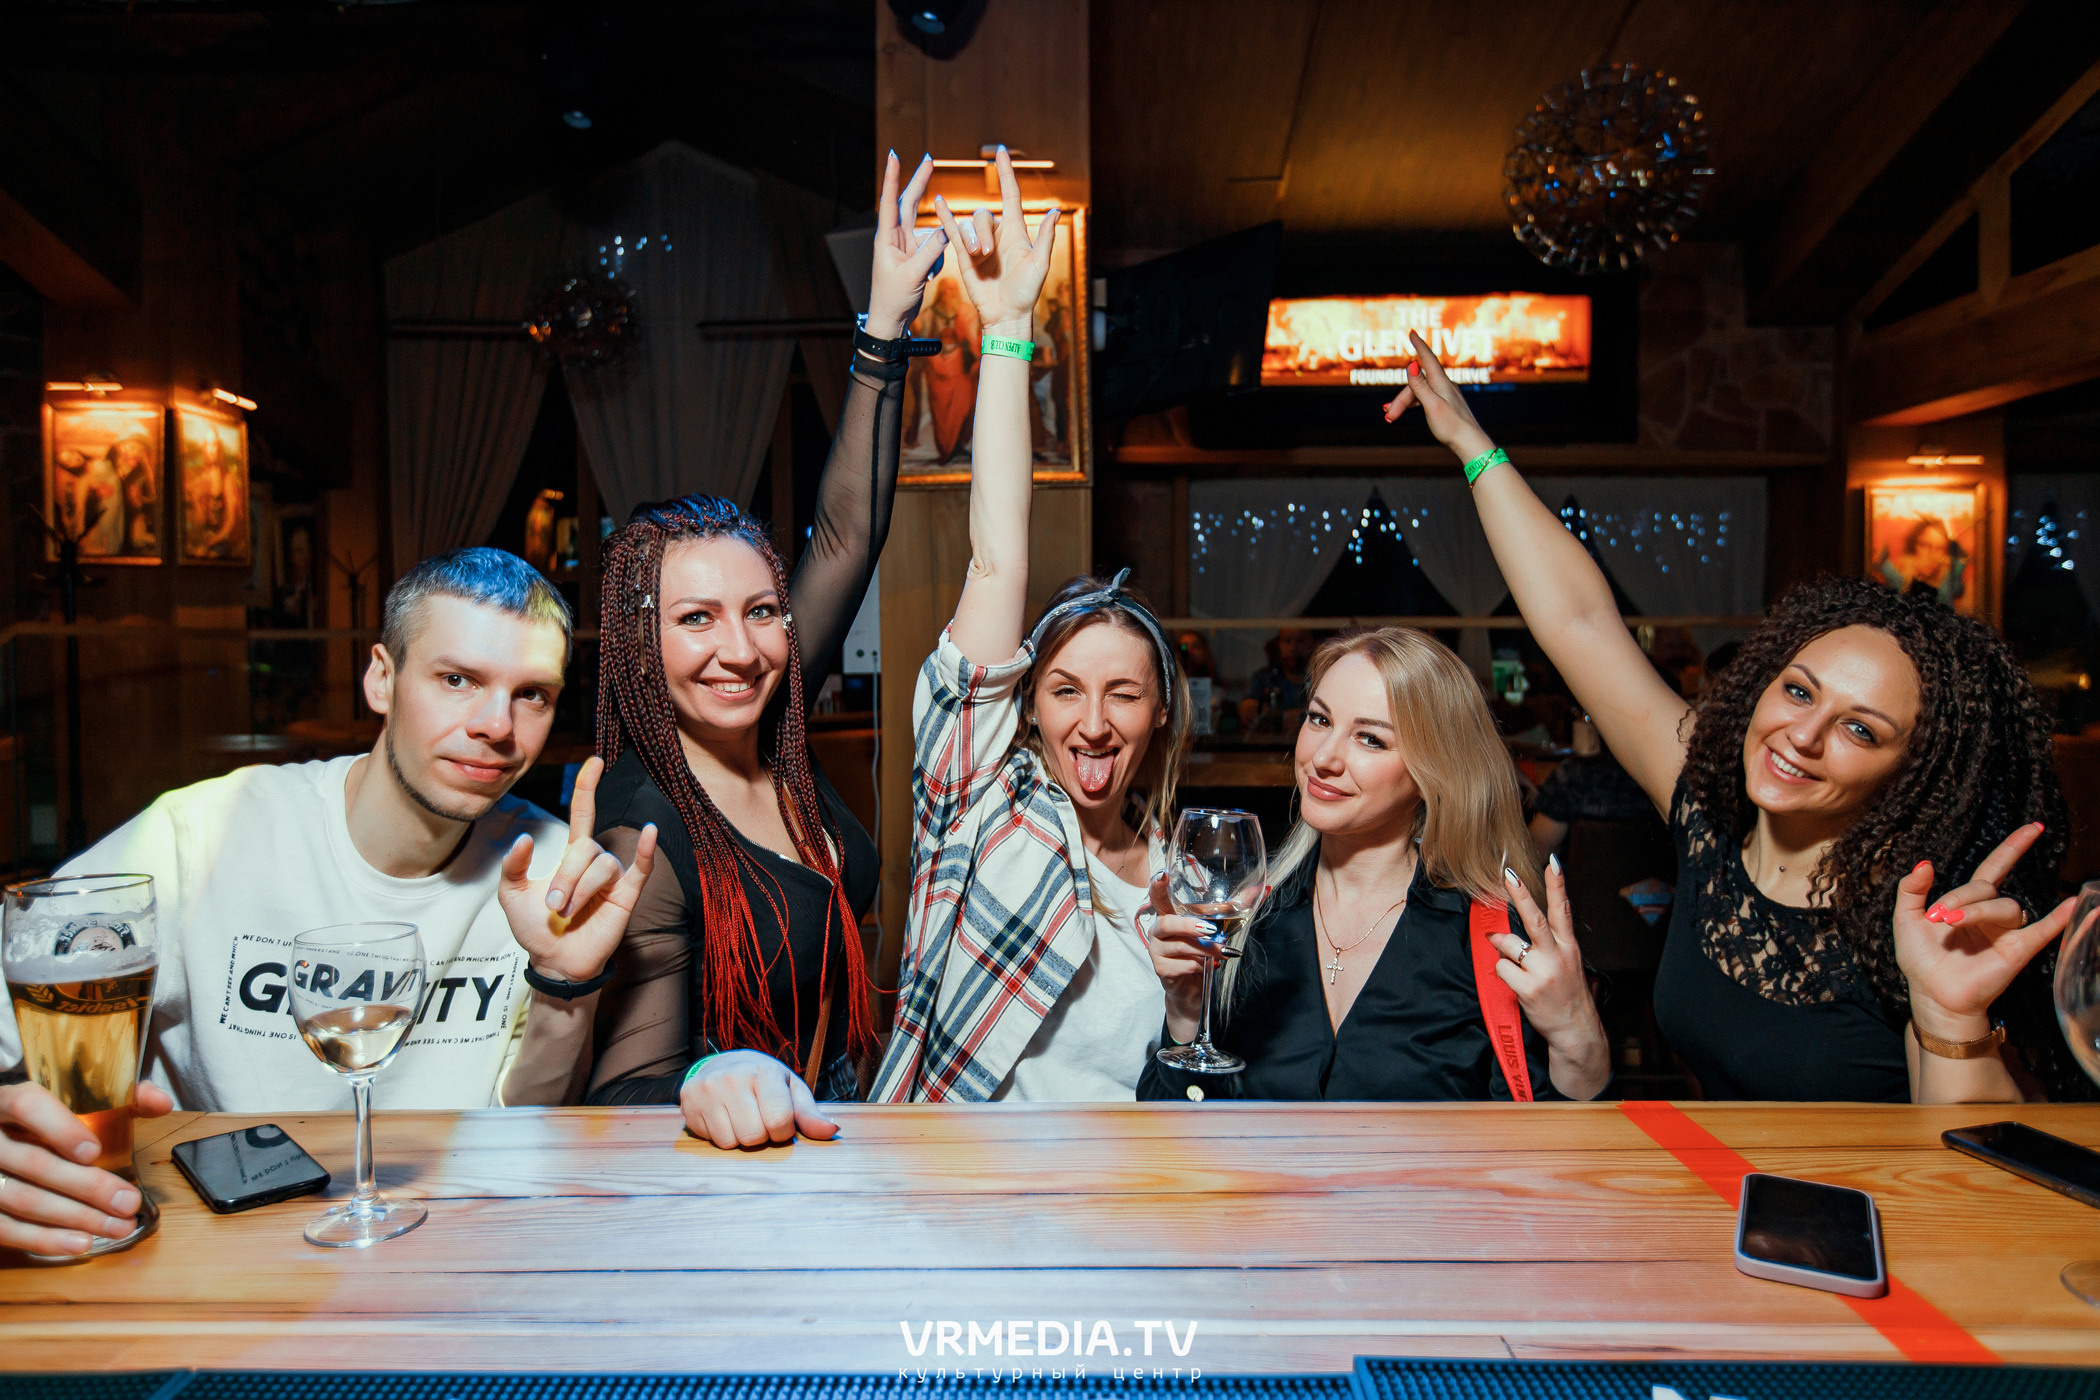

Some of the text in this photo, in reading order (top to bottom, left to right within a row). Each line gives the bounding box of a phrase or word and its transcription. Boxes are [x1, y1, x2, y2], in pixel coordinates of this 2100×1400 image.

[1394, 305, 1442, 328] THE
[1339, 328, 1498, 362] GLENIVET
[1497, 1024, 1519, 1070] LOUIS
